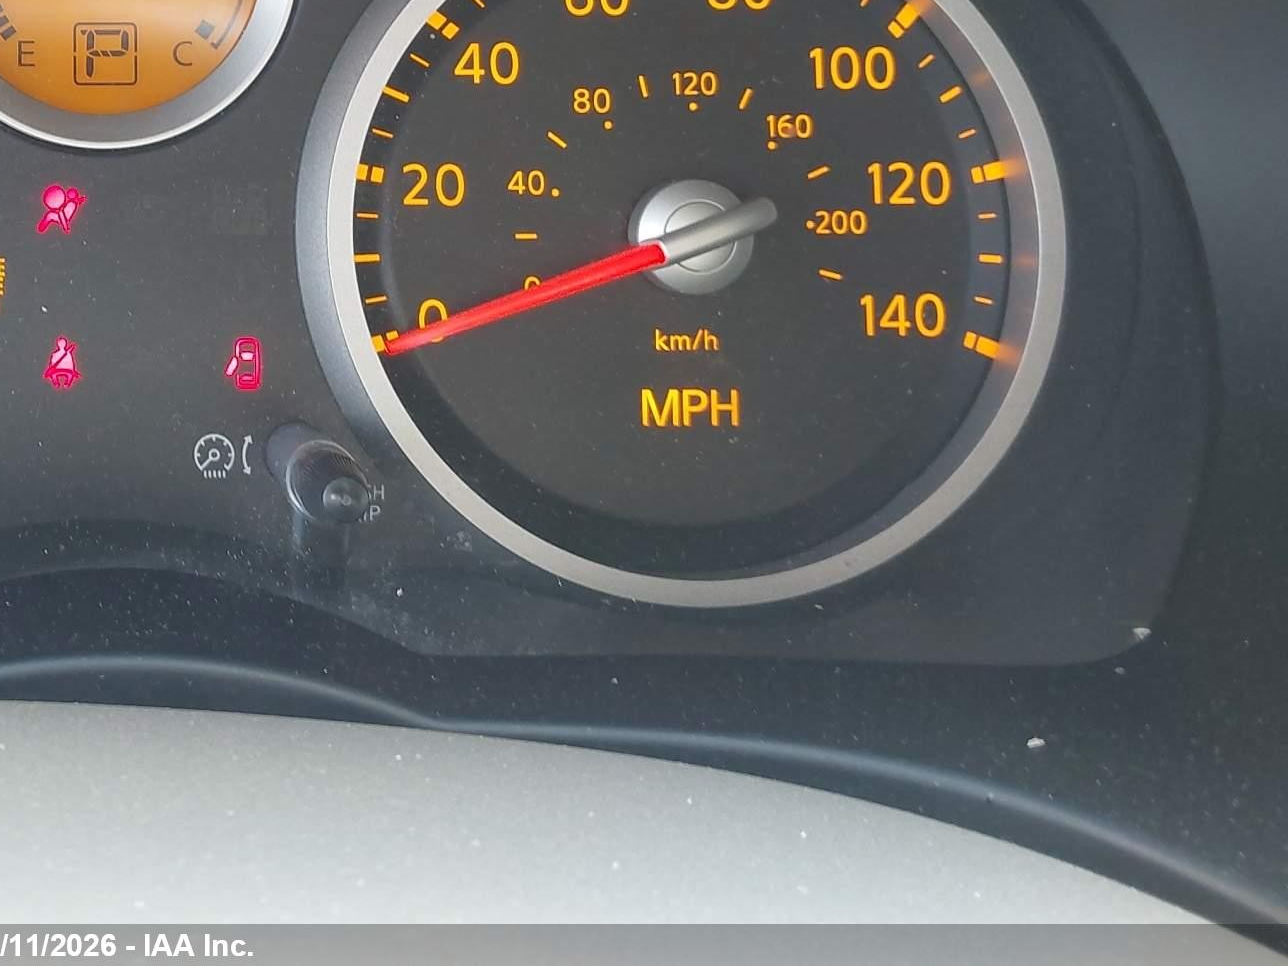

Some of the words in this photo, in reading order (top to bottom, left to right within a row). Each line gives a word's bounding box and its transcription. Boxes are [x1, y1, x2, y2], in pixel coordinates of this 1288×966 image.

[18, 41, 36, 68] E
[80, 28, 129, 78] P
[173, 41, 193, 67] C
[453, 42, 521, 86] 40
[809, 46, 897, 91] 100
[672, 71, 719, 97] 120
[573, 87, 612, 115] 80
[766, 113, 813, 139] 160
[402, 162, 466, 208] 20
[507, 170, 546, 196] 40
[867, 162, 952, 206] 120
[815, 210, 868, 235] 200
[860, 294, 947, 338] 140
[653, 329, 719, 352] km/h
[640, 388, 741, 428] MPH
